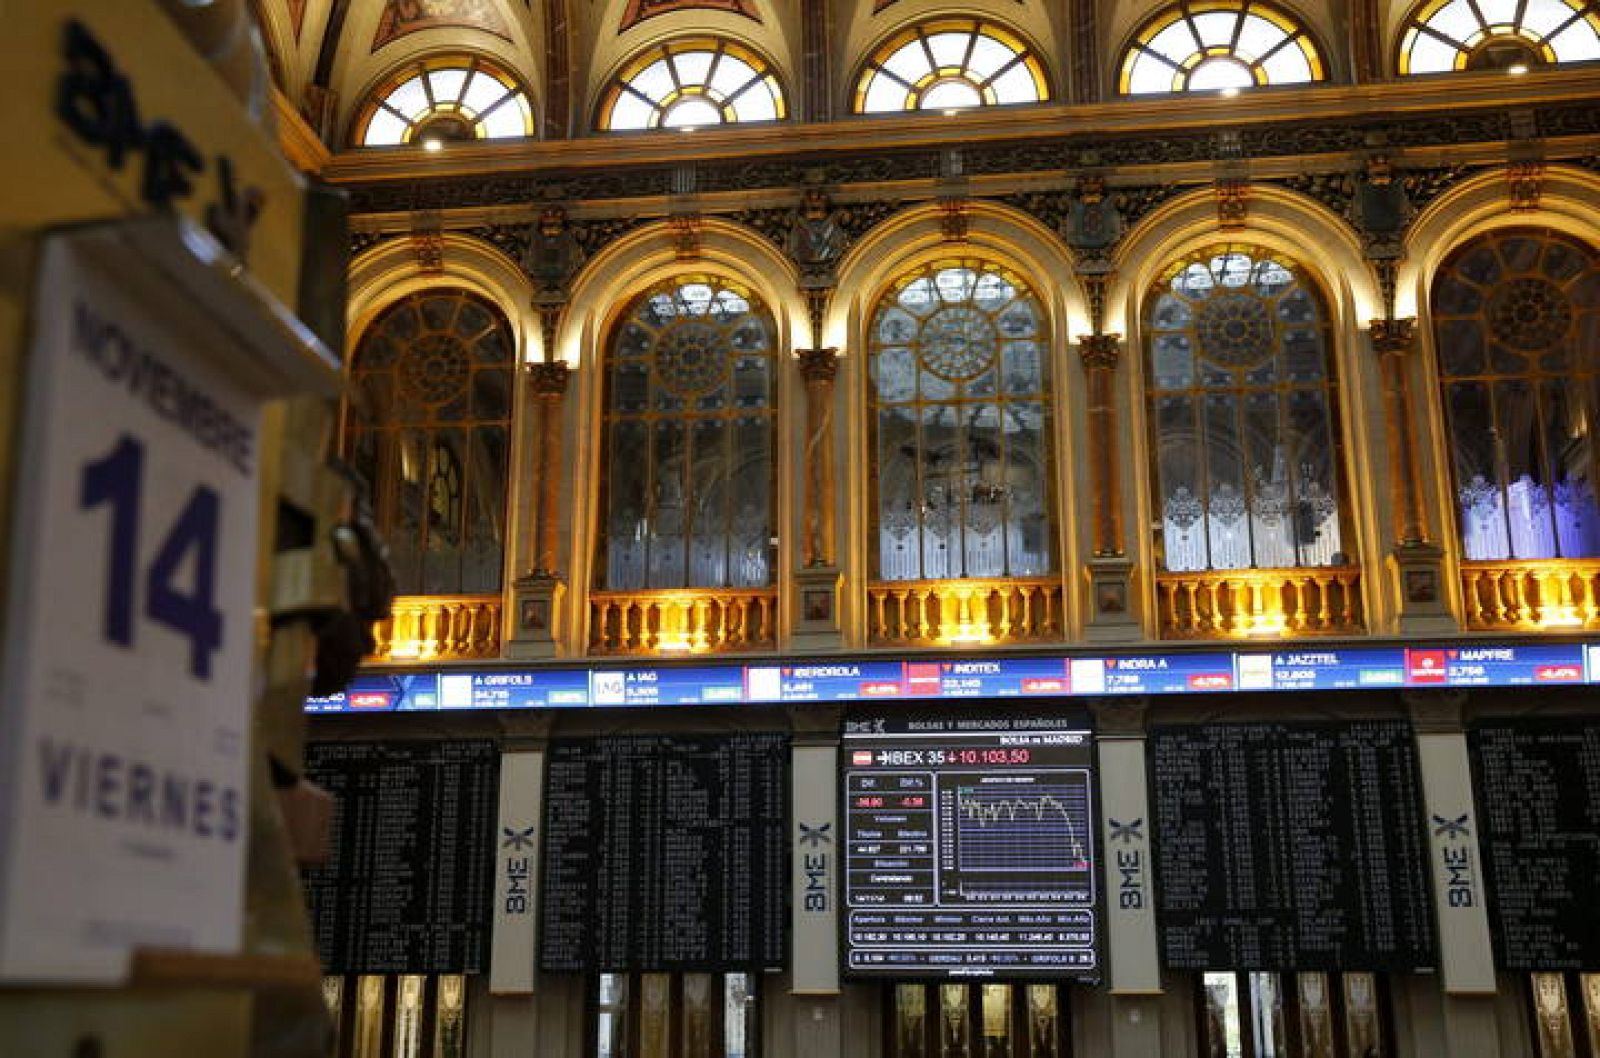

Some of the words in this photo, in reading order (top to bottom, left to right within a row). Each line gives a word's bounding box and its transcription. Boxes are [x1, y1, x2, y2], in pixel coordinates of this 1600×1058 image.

[73, 302, 256, 480] NOVIEMBRE
[80, 432, 225, 683] 14
[1286, 652, 1339, 665] JAZZTEL
[1460, 648, 1514, 660] MAPFRE
[1119, 659, 1156, 670] INDRA
[1158, 659, 1168, 669] A
[638, 672, 659, 682] IAG
[795, 666, 861, 678] IBERDROLA
[484, 675, 534, 686] GRIFOLS
[957, 719, 1010, 729] MERCADOS
[1012, 718, 1068, 728] ESPAÑOLES
[1043, 735, 1083, 745] MADRID
[886, 750, 923, 766] IBEX
[927, 750, 946, 765] 35
[39, 733, 240, 843] VIERNES
[804, 852, 826, 912] BME
[1117, 848, 1143, 910] BME
[1443, 846, 1472, 908] BME
[506, 856, 528, 914] BME
